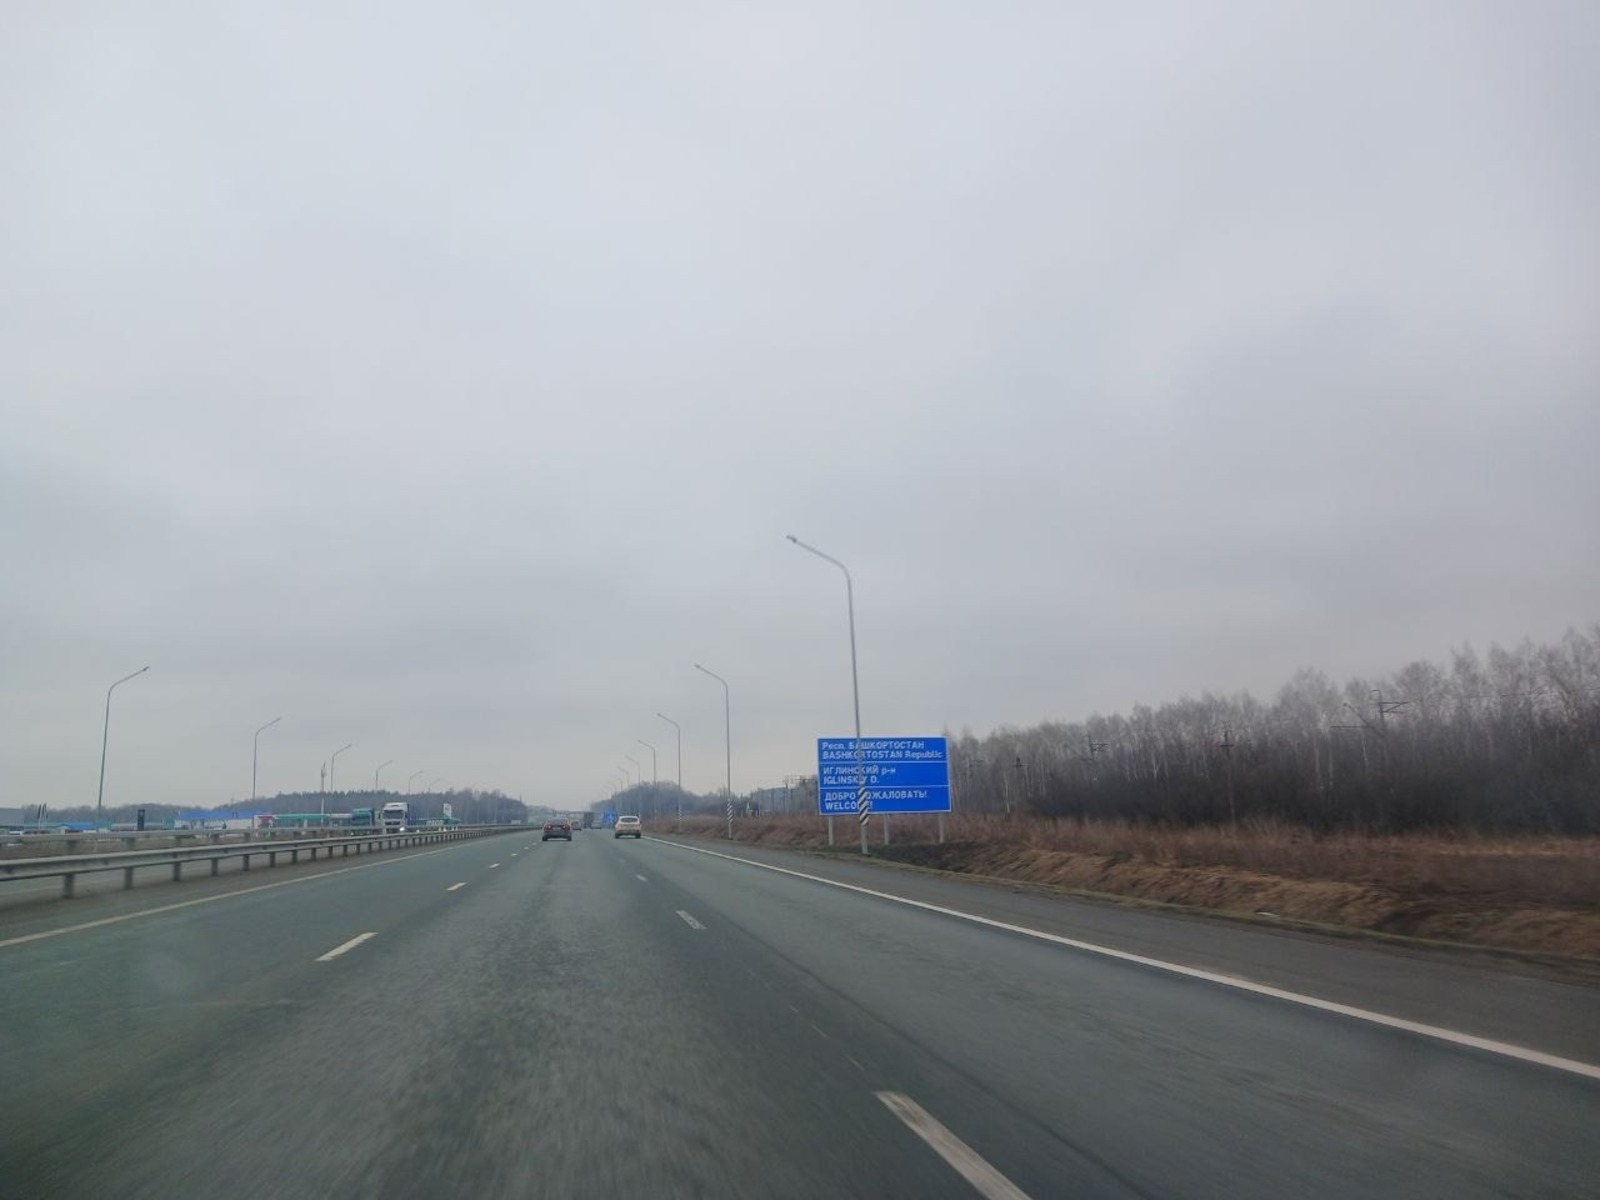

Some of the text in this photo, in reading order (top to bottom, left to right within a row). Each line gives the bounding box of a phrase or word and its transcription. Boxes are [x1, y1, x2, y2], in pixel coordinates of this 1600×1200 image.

[822, 741, 846, 750] Респ.
[905, 750, 943, 760] Republic
[881, 767, 896, 775] р-н
[823, 775, 880, 785] IGLINSKY D.
[825, 790, 928, 801] ДОБРО ОЖАЛОВАТЬ!
